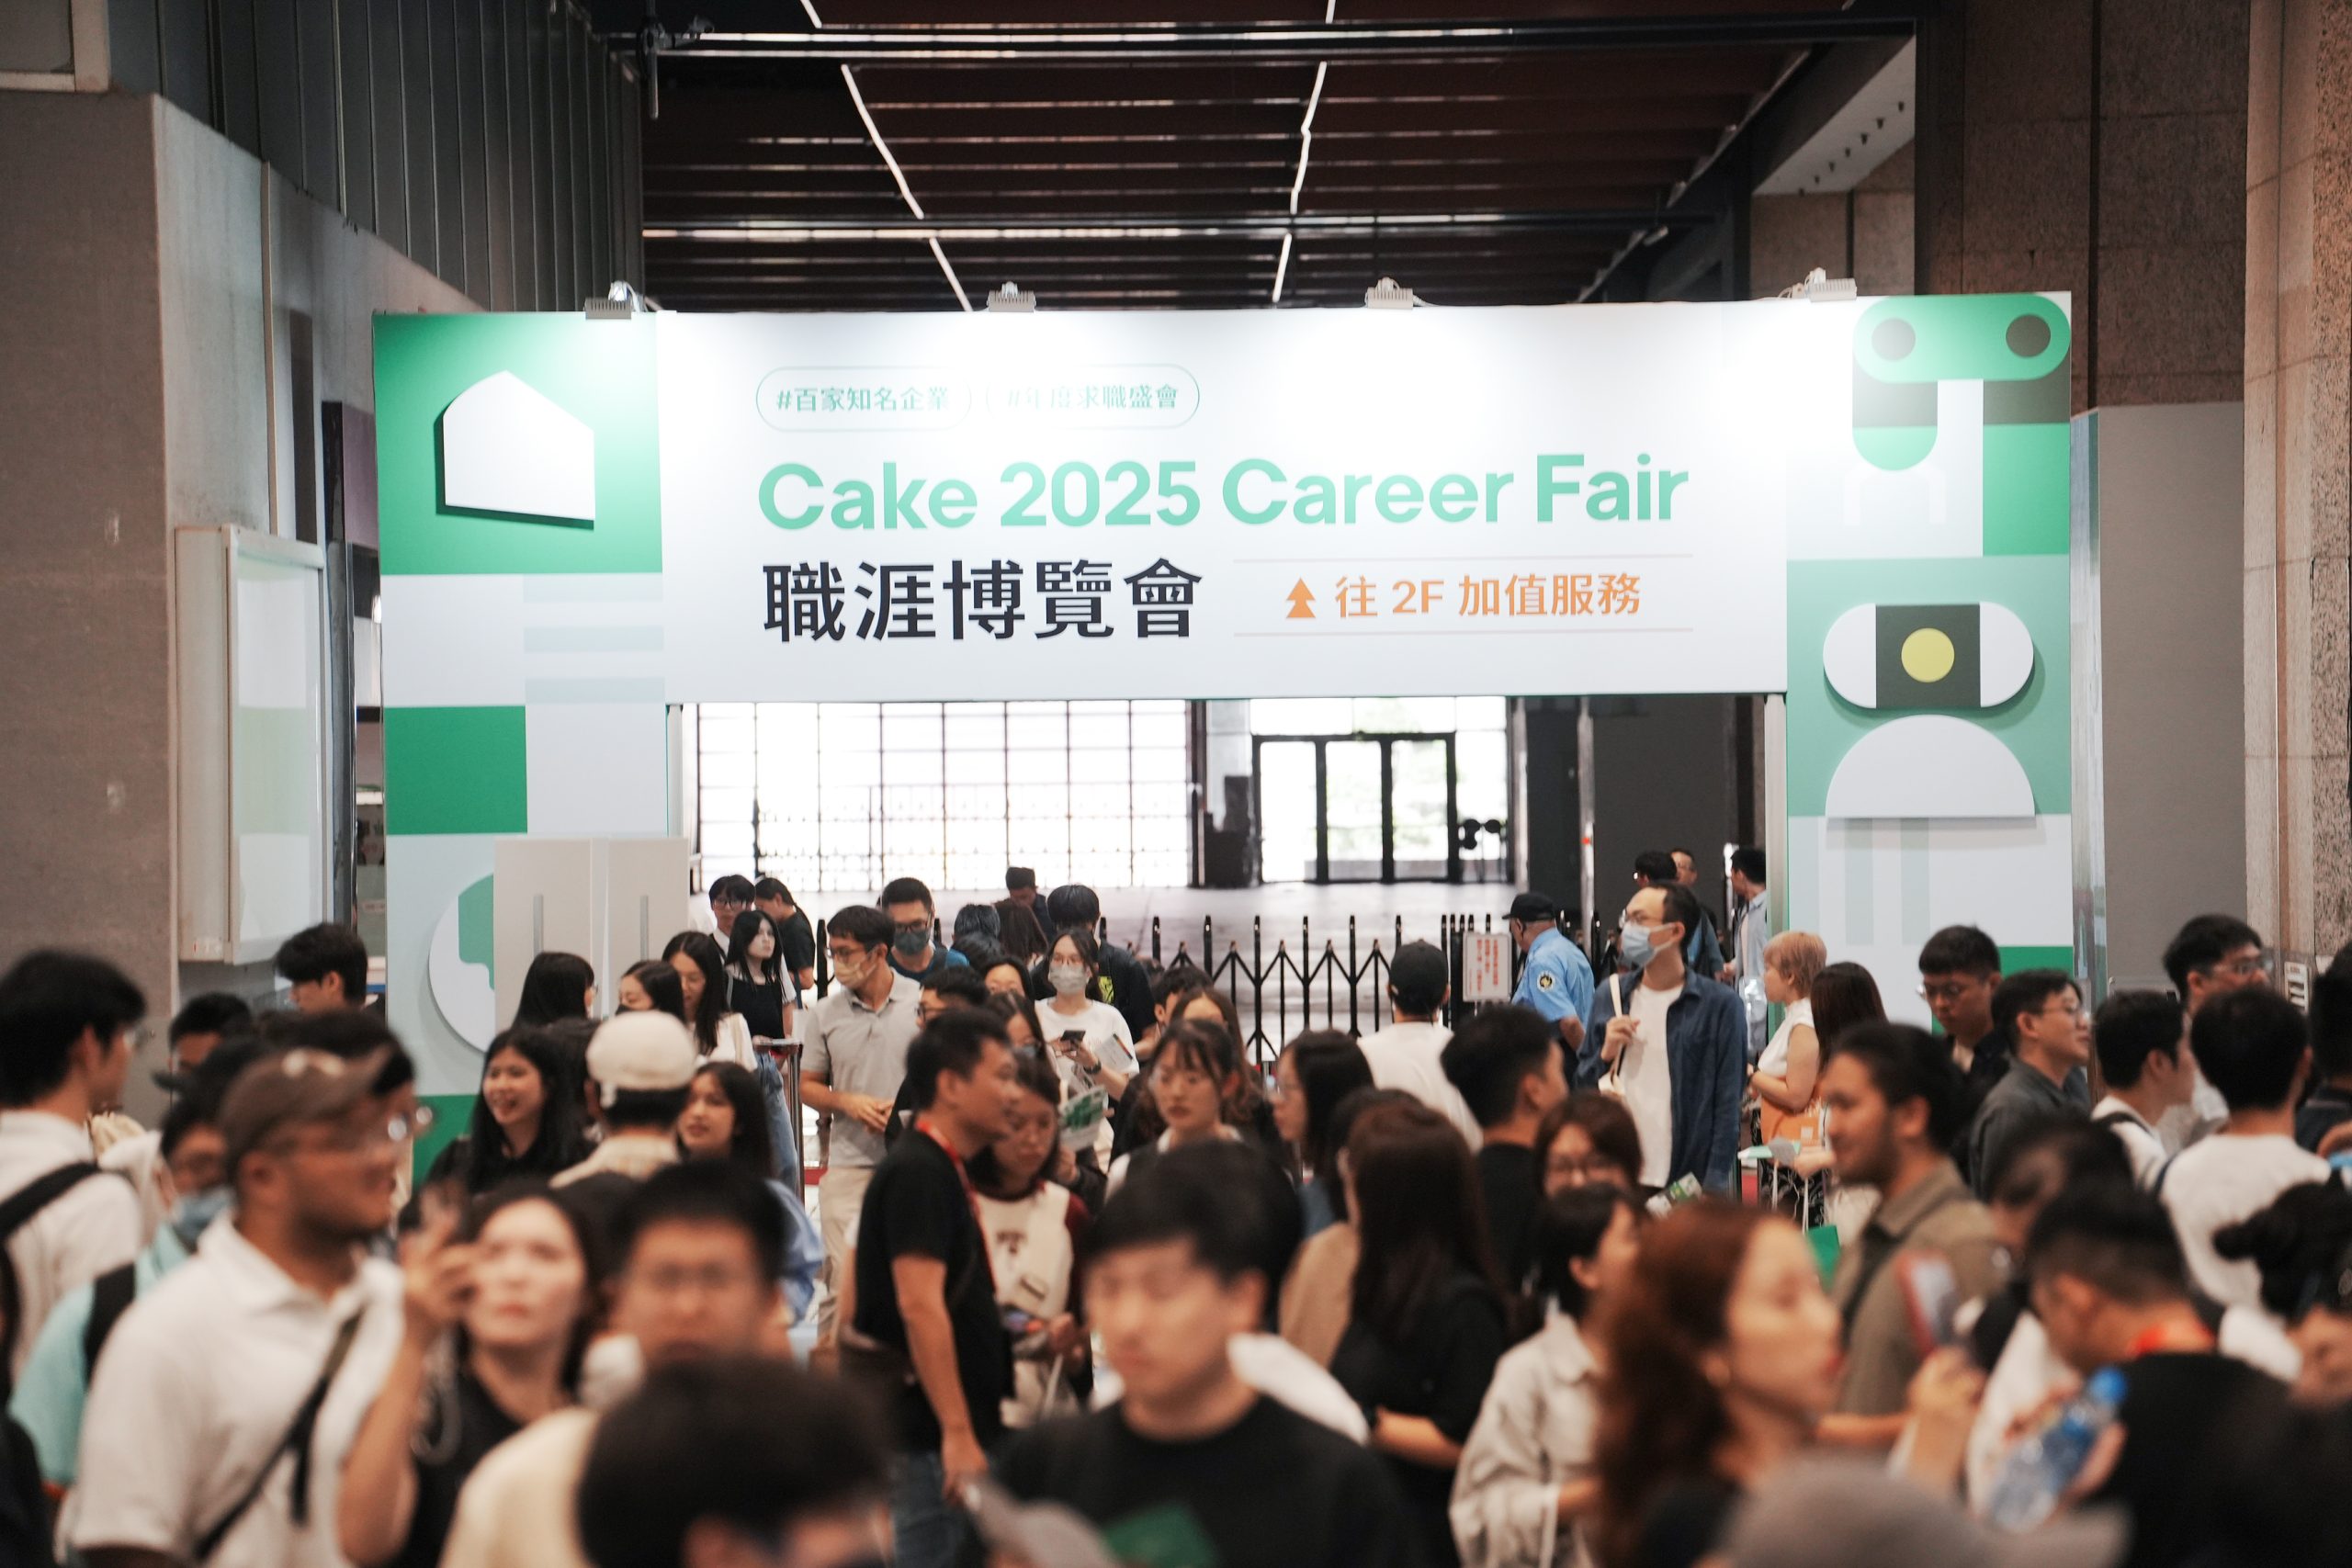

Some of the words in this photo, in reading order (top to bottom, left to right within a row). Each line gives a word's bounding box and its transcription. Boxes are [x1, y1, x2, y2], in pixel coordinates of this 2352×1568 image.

[775, 386, 950, 412] #百家知名企業
[758, 461, 978, 531] Cake
[1000, 460, 1201, 527] 2025
[1222, 457, 1514, 525] Career
[1536, 453, 1689, 523] Fair
[763, 557, 1204, 643] 職涯博覽會
[1335, 574, 1378, 619] 往
[1392, 579, 1444, 615] 2F
[1458, 571, 1641, 617] 加值服務
